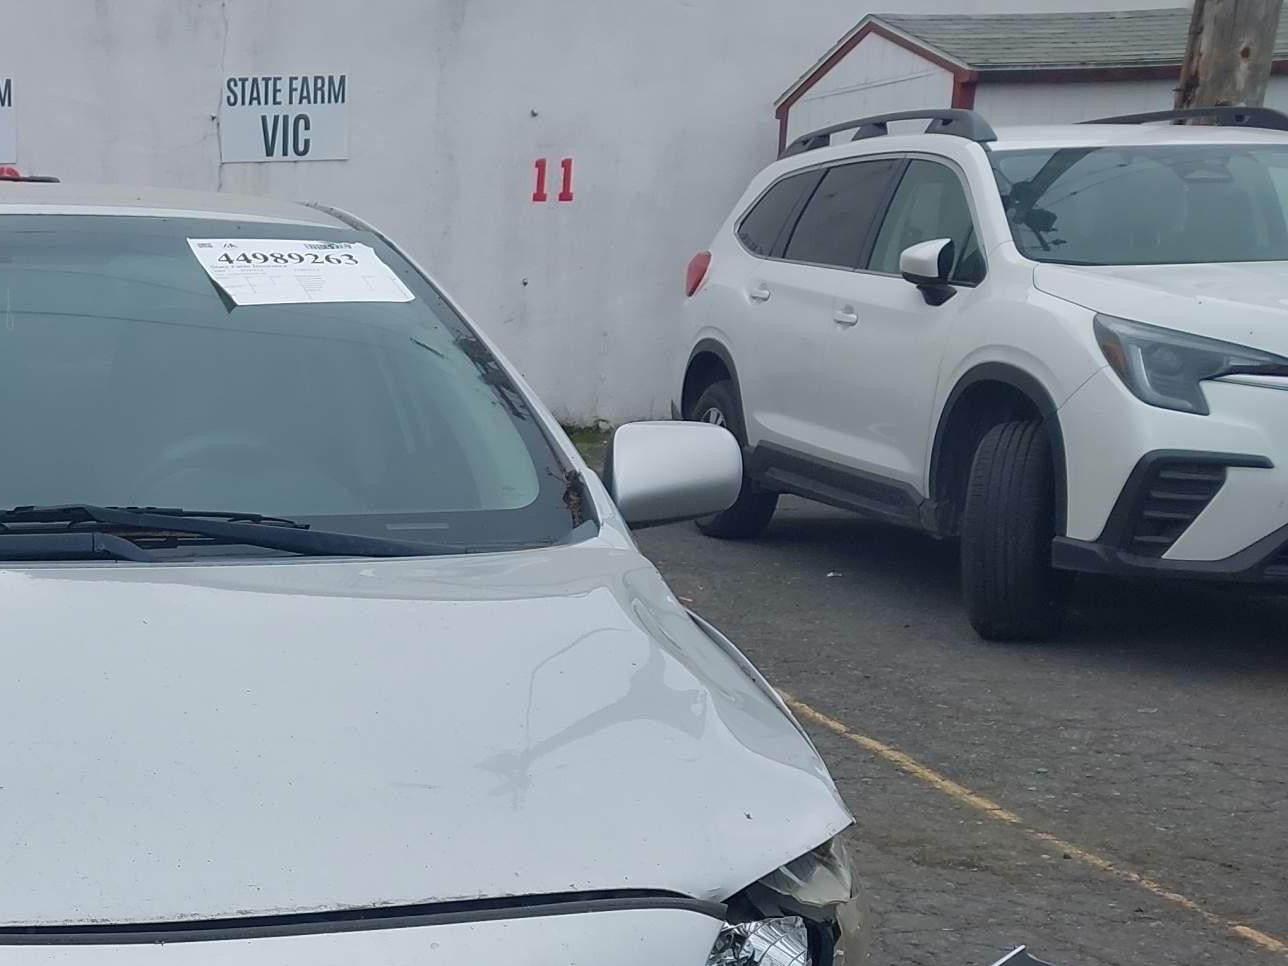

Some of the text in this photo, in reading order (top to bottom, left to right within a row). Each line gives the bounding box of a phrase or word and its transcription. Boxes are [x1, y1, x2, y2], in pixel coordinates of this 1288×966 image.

[226, 74, 346, 107] STATE FARM
[260, 113, 311, 157] VIC
[532, 158, 574, 202] 11
[217, 252, 360, 266] 44989263
